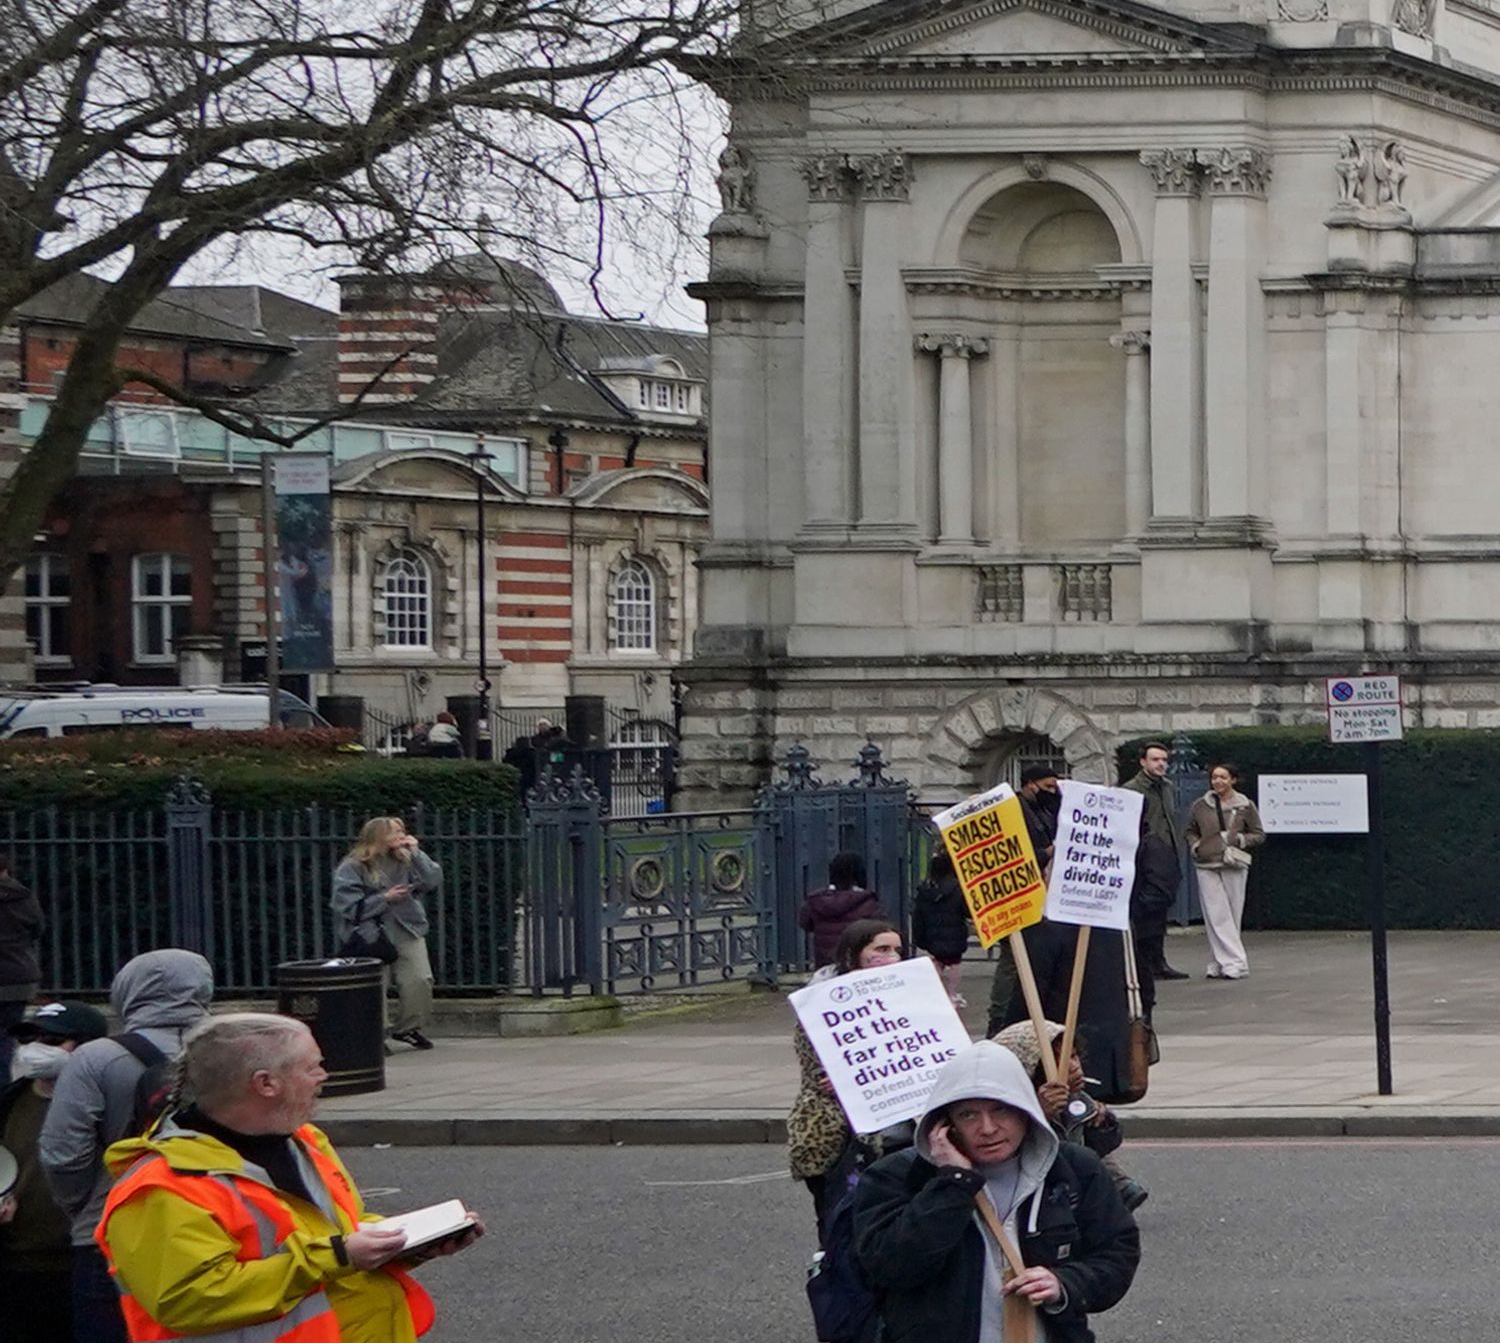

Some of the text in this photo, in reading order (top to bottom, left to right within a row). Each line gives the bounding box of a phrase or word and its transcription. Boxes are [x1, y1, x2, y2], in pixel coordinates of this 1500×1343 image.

[1357, 691, 1395, 700] ROUTE
[1364, 682, 1387, 690] RED
[121, 707, 204, 719] POLICE
[1334, 710, 1348, 718] No
[1072, 809, 1108, 829] Don't
[949, 811, 1002, 852] SMASH
[1070, 829, 1113, 848] let the
[959, 835, 1023, 883] FASCISM
[1067, 847, 1120, 870] far right
[970, 861, 1039, 911] & RACISM
[1064, 867, 1124, 888] divide us
[822, 998, 887, 1028] Don't
[832, 1017, 911, 1047] let the
[842, 1029, 942, 1066] far right
[854, 1057, 926, 1086] divide
[931, 1048, 958, 1063] us
[862, 1076, 915, 1101] Defend
